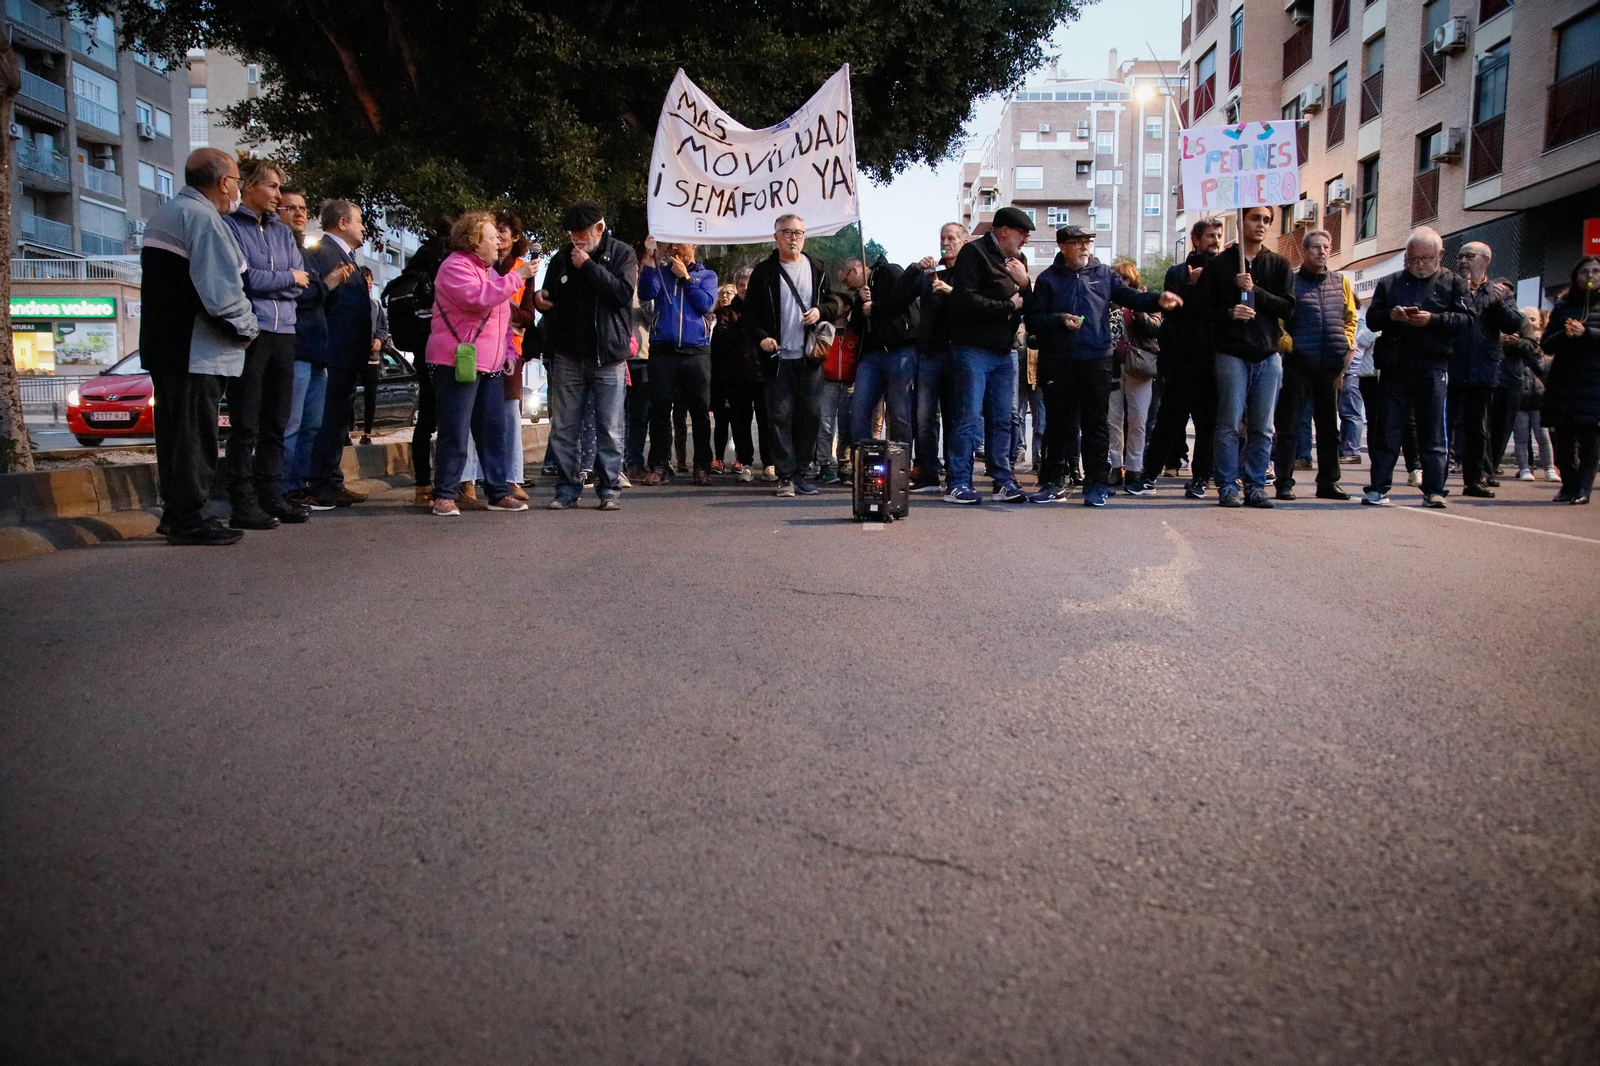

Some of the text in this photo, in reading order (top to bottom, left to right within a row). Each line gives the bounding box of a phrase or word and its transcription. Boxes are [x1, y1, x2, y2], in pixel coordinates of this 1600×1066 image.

[1183, 135, 1207, 160] LOS
[1205, 141, 1293, 175] PEATONES
[61, 300, 113, 316] valero
[95, 412, 113, 420] 2117
